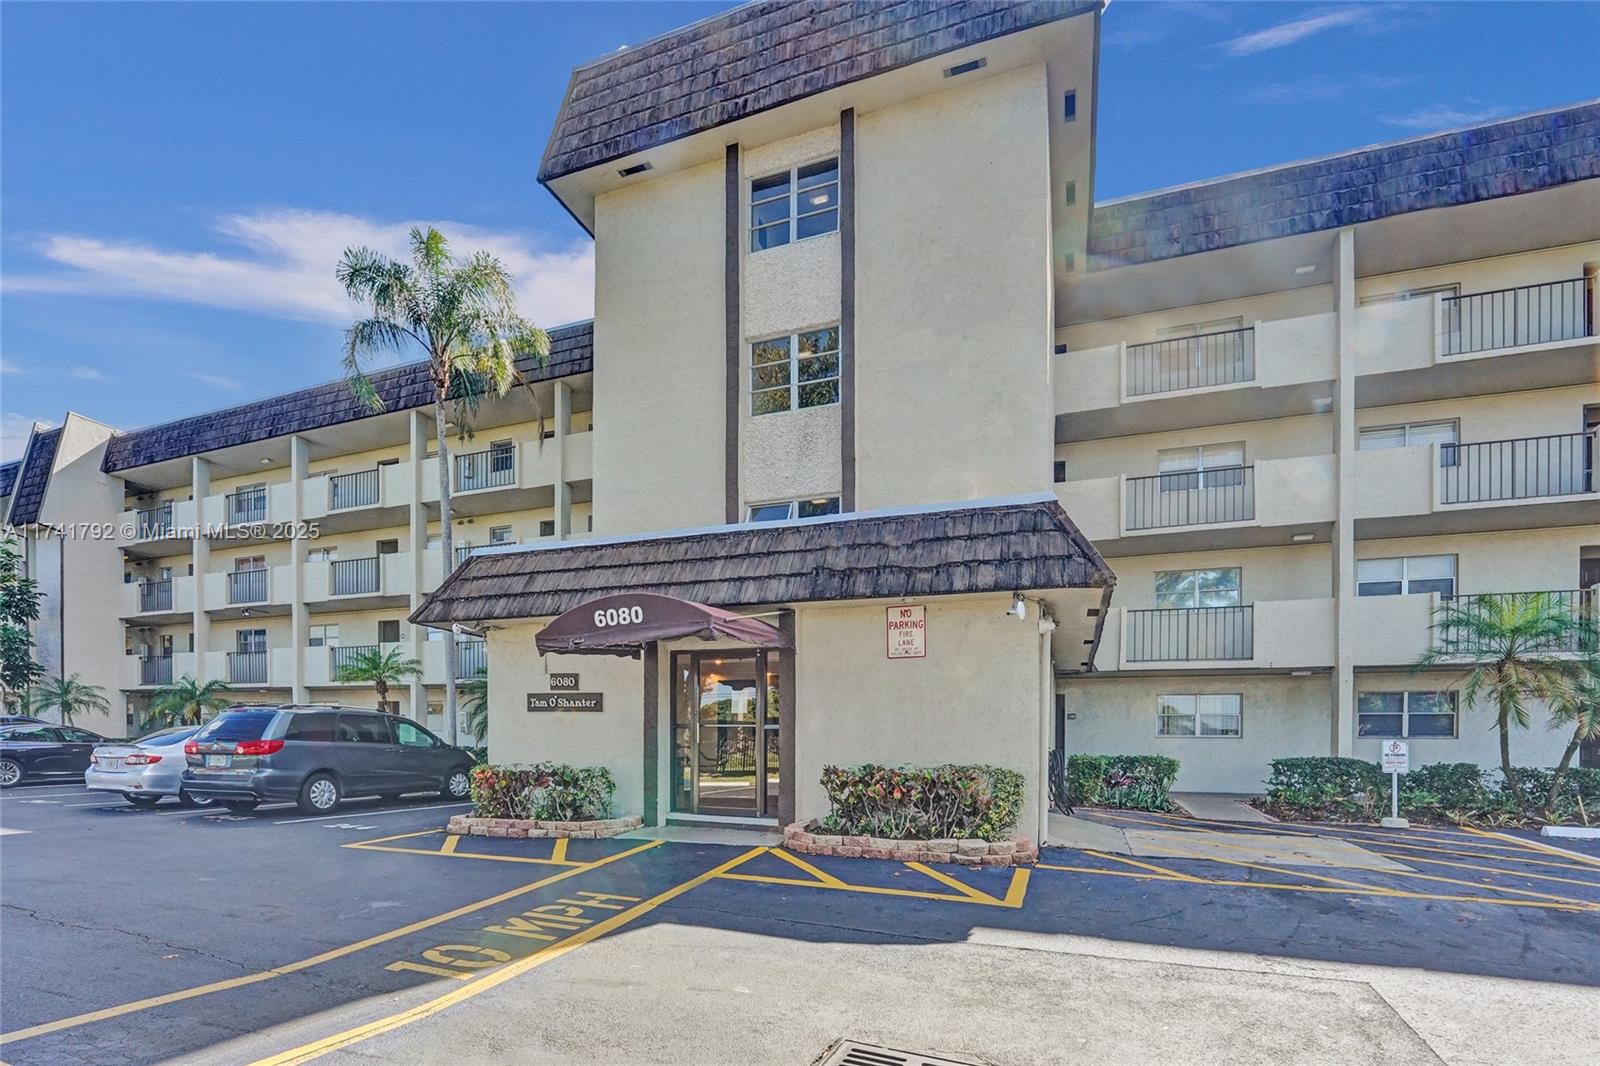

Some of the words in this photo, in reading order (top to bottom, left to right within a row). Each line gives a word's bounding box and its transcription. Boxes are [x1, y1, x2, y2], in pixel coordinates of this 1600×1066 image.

[594, 606, 643, 627] 6080
[900, 609, 912, 618] NO
[888, 620, 924, 630] PARKING
[899, 630, 913, 638] FIRE
[897, 639, 914, 647] LANE
[550, 677, 575, 687] 6080
[530, 698, 548, 708] Tam
[384, 944, 512, 981] 10
[482, 891, 642, 942] MPH
